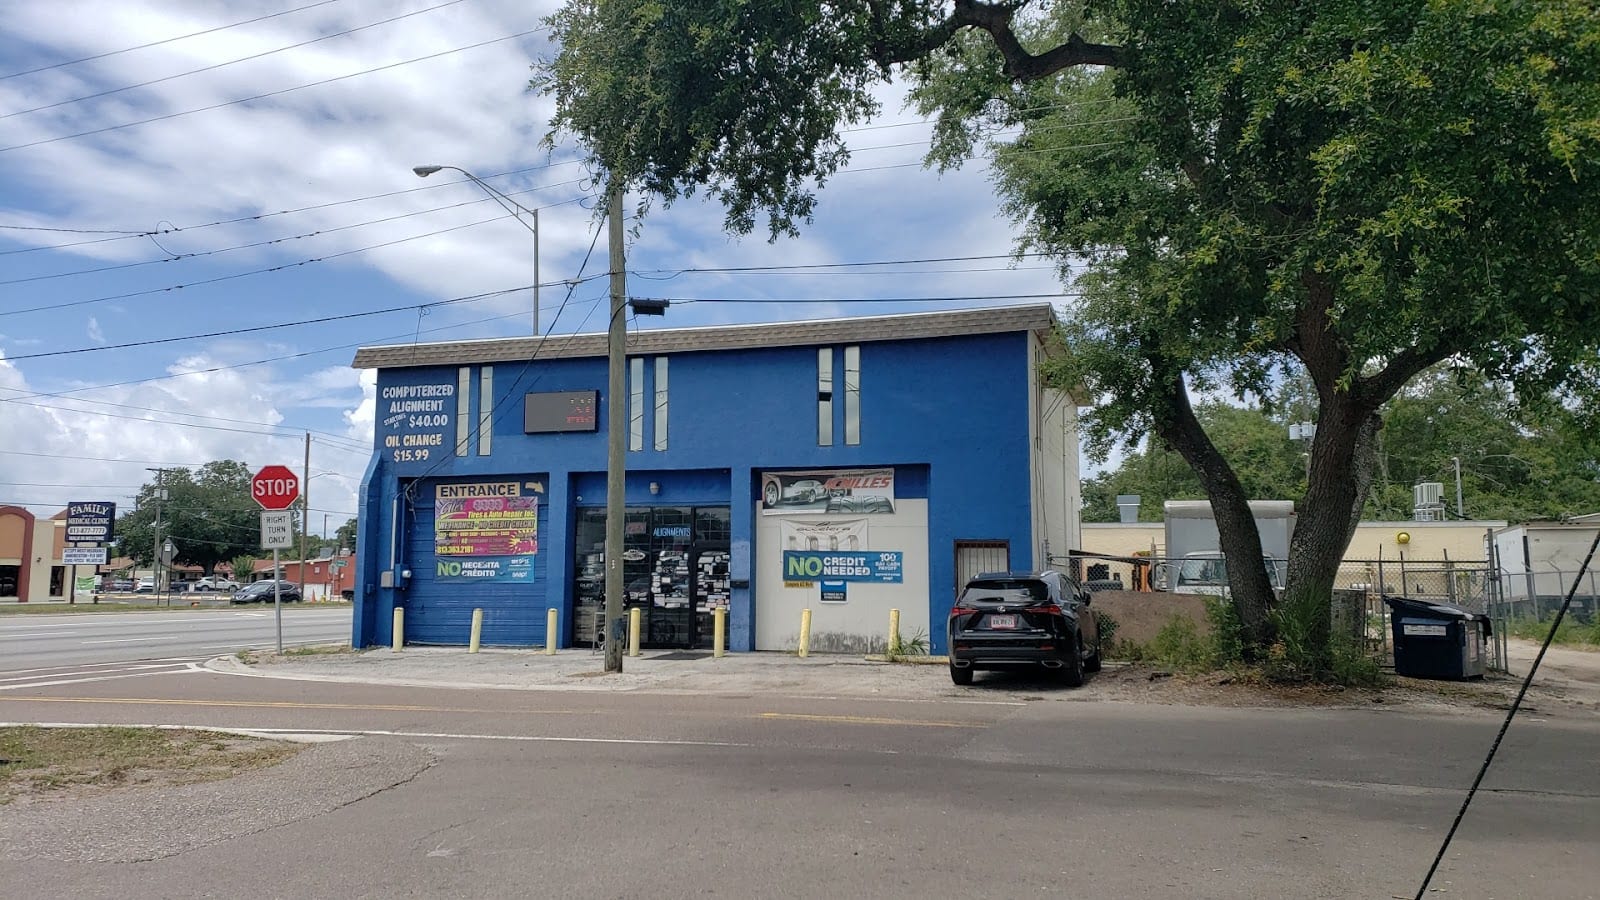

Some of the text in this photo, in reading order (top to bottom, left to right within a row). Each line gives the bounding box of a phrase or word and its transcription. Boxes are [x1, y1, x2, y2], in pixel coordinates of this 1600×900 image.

[383, 385, 454, 399] COMPUTERIZED
[390, 400, 444, 413] ALIGNMENT
[409, 414, 448, 428] $40.00
[385, 434, 442, 447] OIL CHANGE
[394, 449, 429, 462] $15.99
[255, 479, 296, 496] STOP
[440, 484, 516, 497] ENTRANCE
[70, 503, 109, 515] FAMILY
[266, 515, 286, 524] RIGHT
[268, 526, 286, 534] TURN
[652, 527, 691, 537] ALIGNMENTS
[268, 536, 286, 544] ONLY
[880, 553, 896, 562] 100
[437, 562, 461, 577] NO
[462, 561, 500, 569] NECESITA
[461, 568, 495, 577] CRÉDITO
[788, 556, 866, 576] NO CREDIT
[823, 566, 871, 576] NEEDED
